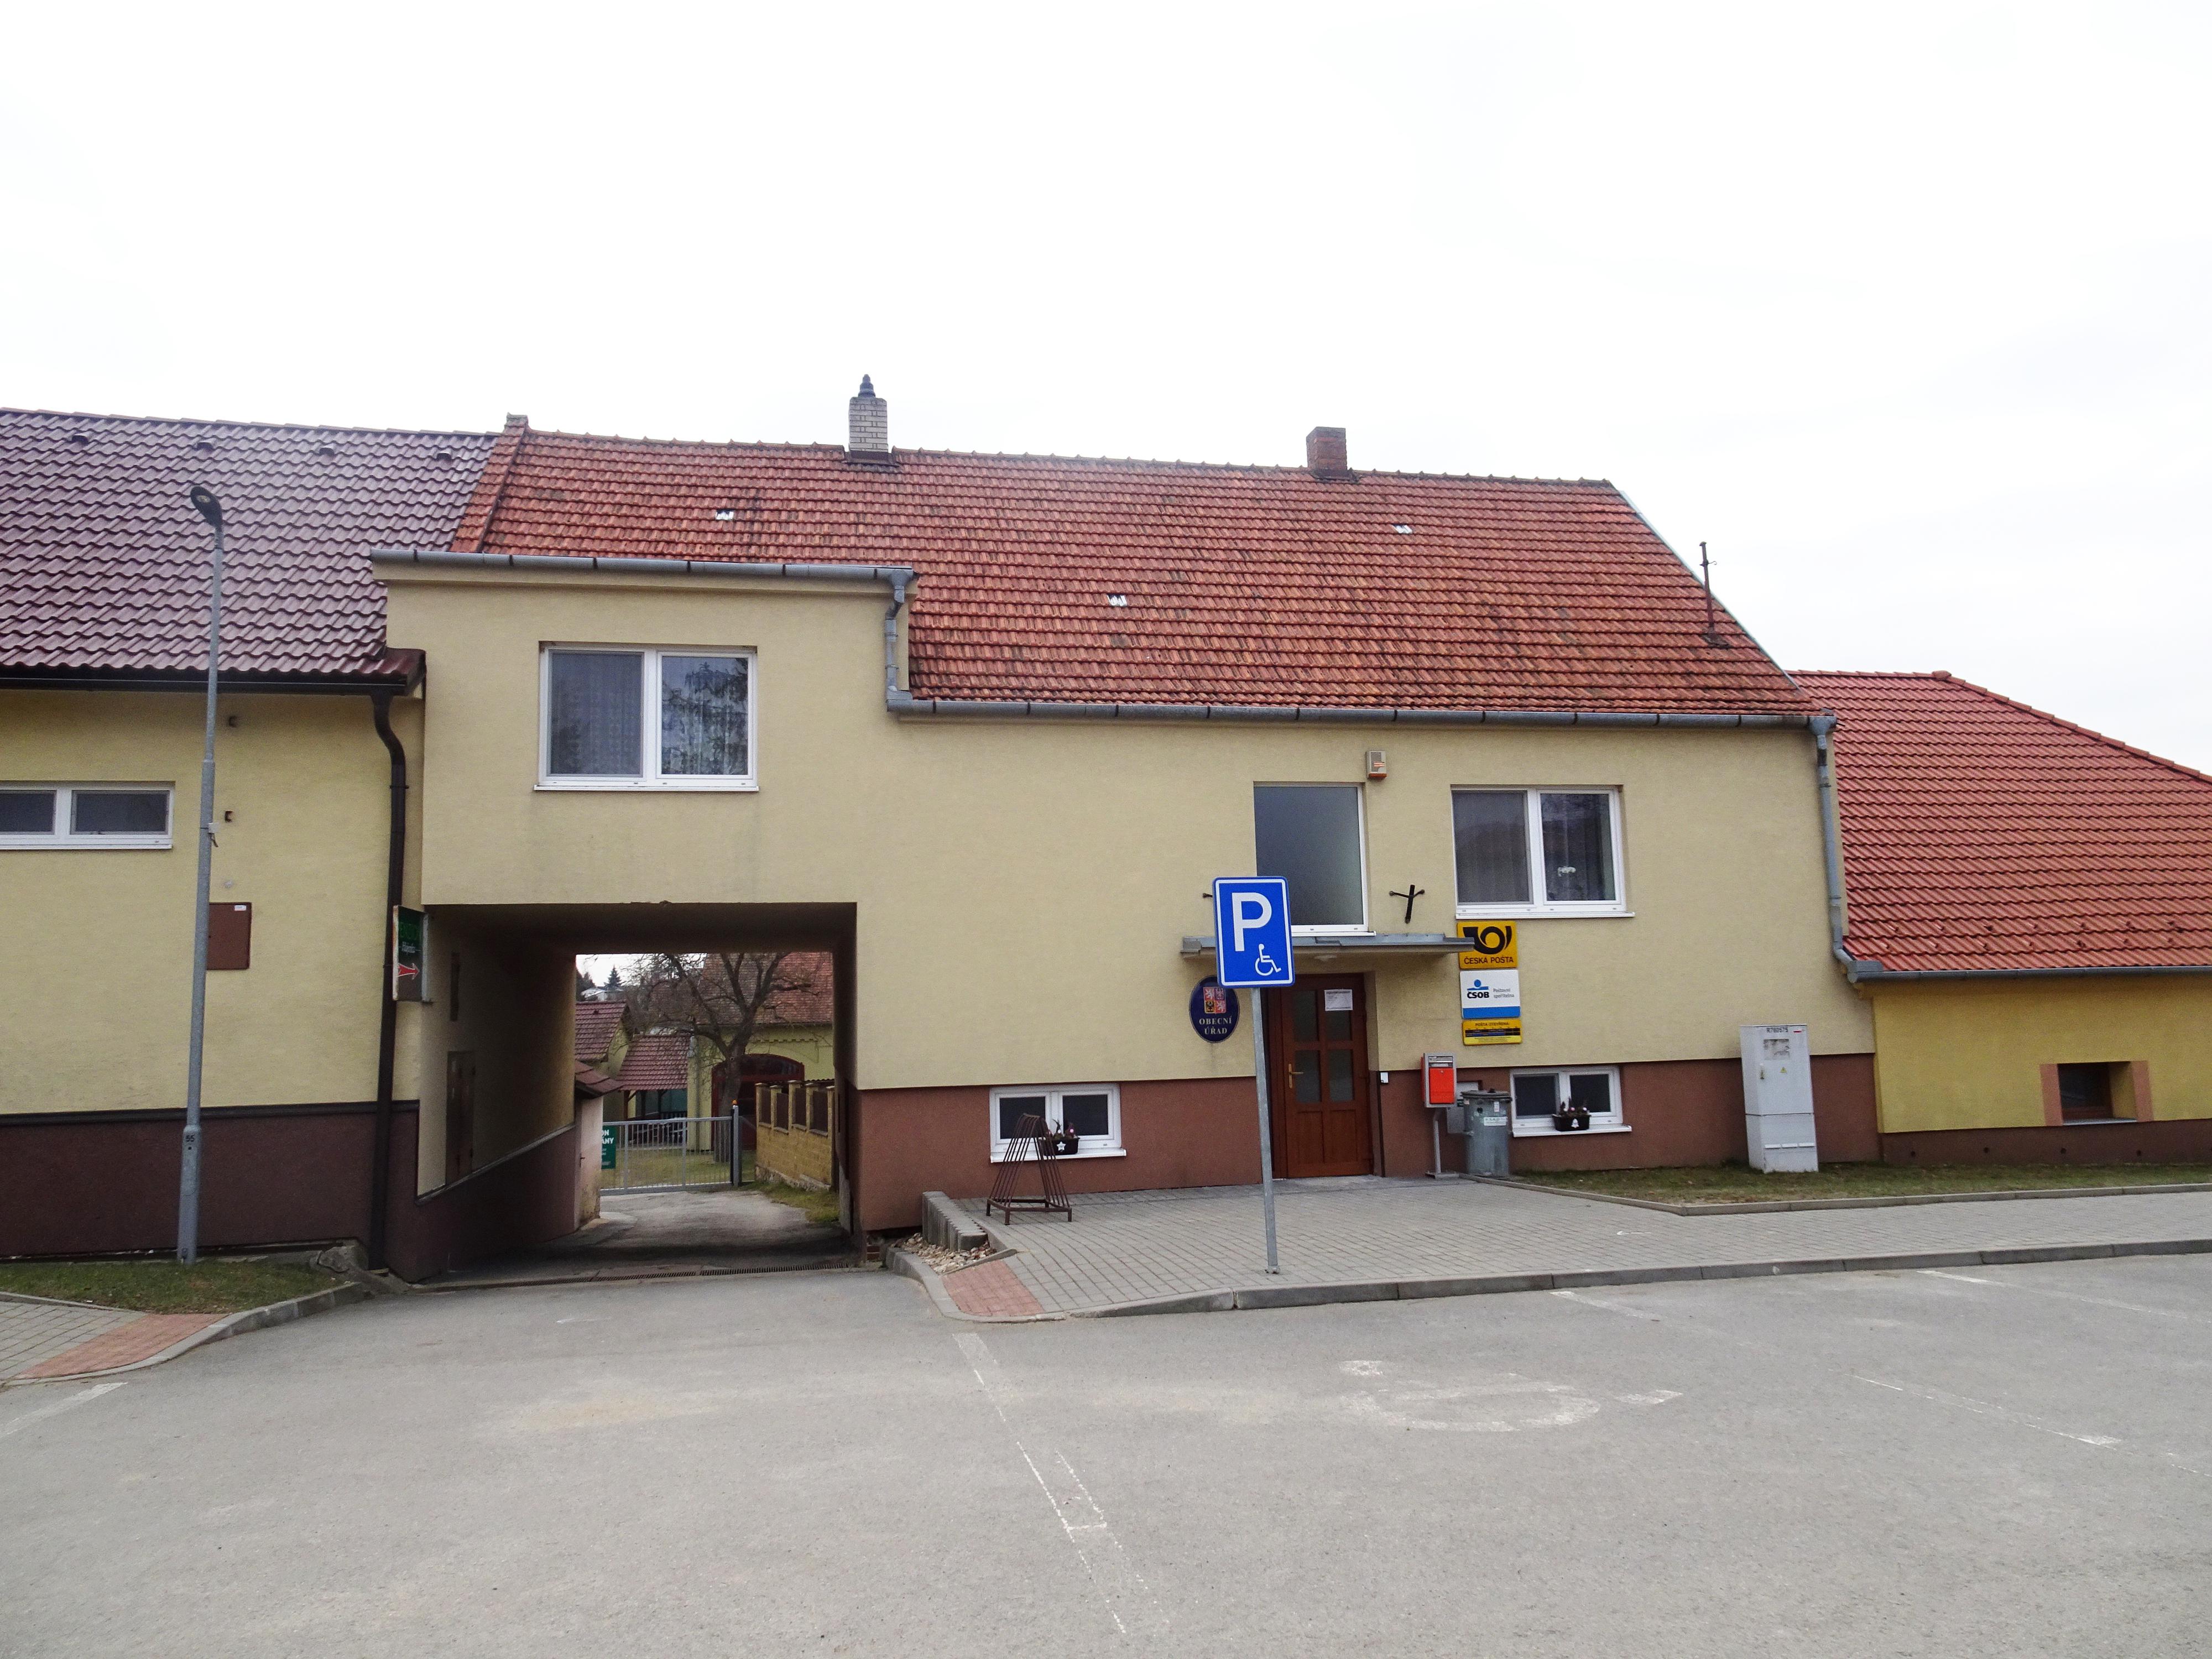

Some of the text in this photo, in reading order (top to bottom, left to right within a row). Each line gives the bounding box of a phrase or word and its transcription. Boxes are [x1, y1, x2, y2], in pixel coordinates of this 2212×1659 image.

[1232, 892, 1272, 952] P
[1490, 954, 1514, 963] POŠTA
[1198, 1015, 1233, 1025] OBECNÍ
[1204, 1026, 1228, 1035] ÚŘAD
